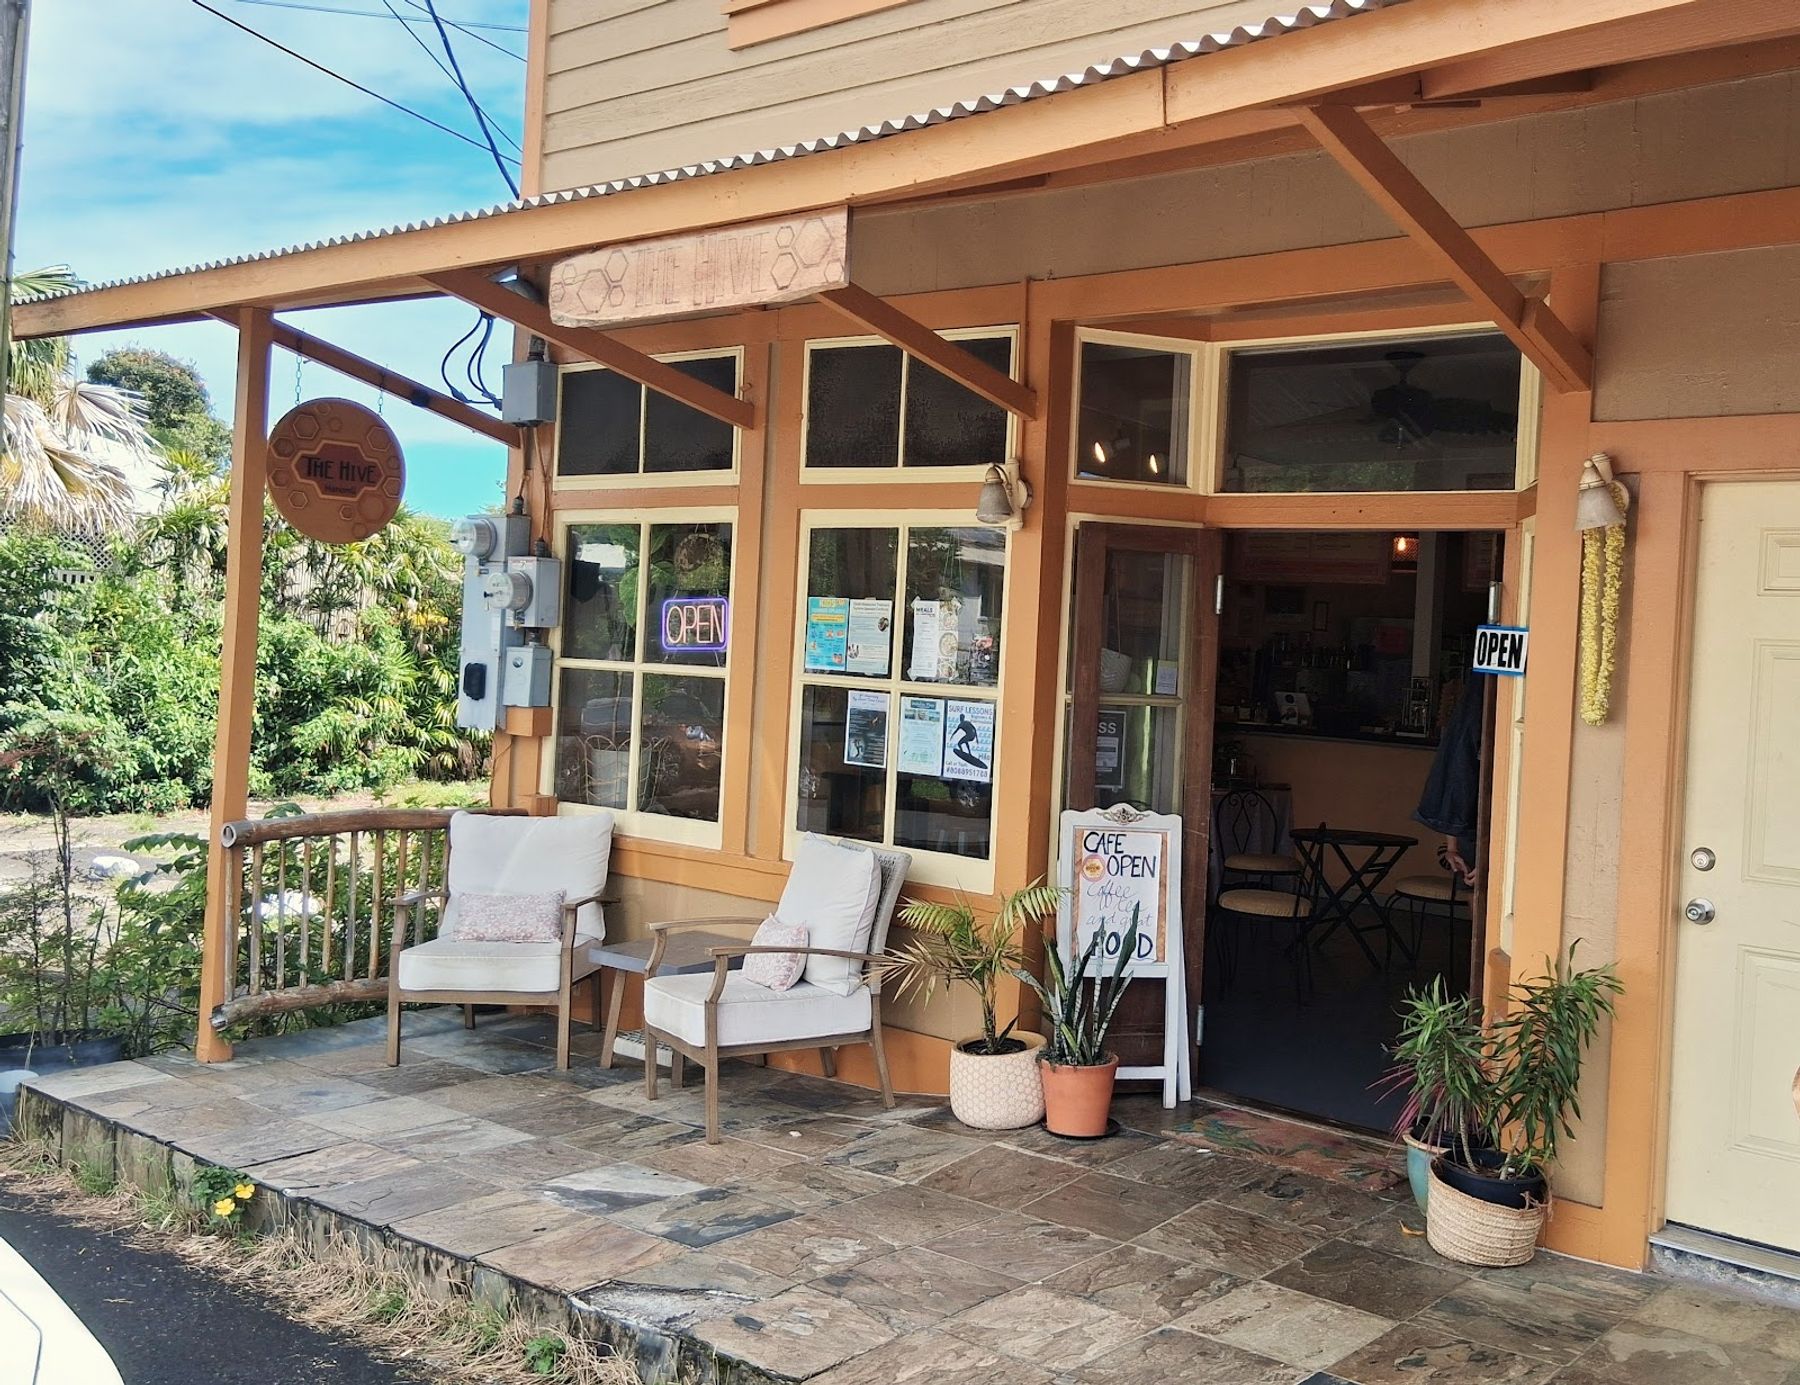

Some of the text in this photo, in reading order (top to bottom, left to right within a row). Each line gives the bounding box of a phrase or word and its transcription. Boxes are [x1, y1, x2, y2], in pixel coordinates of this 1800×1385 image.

[631, 231, 770, 308] THE HIVE
[301, 456, 377, 483] THE HIVE
[666, 605, 725, 643] OPEN
[1478, 632, 1523, 668] OPEN
[949, 704, 993, 716] SURF LESSONS
[1098, 722, 1117, 734] SS
[1083, 831, 1127, 855] CAFE
[1107, 854, 1157, 879] OPEN
